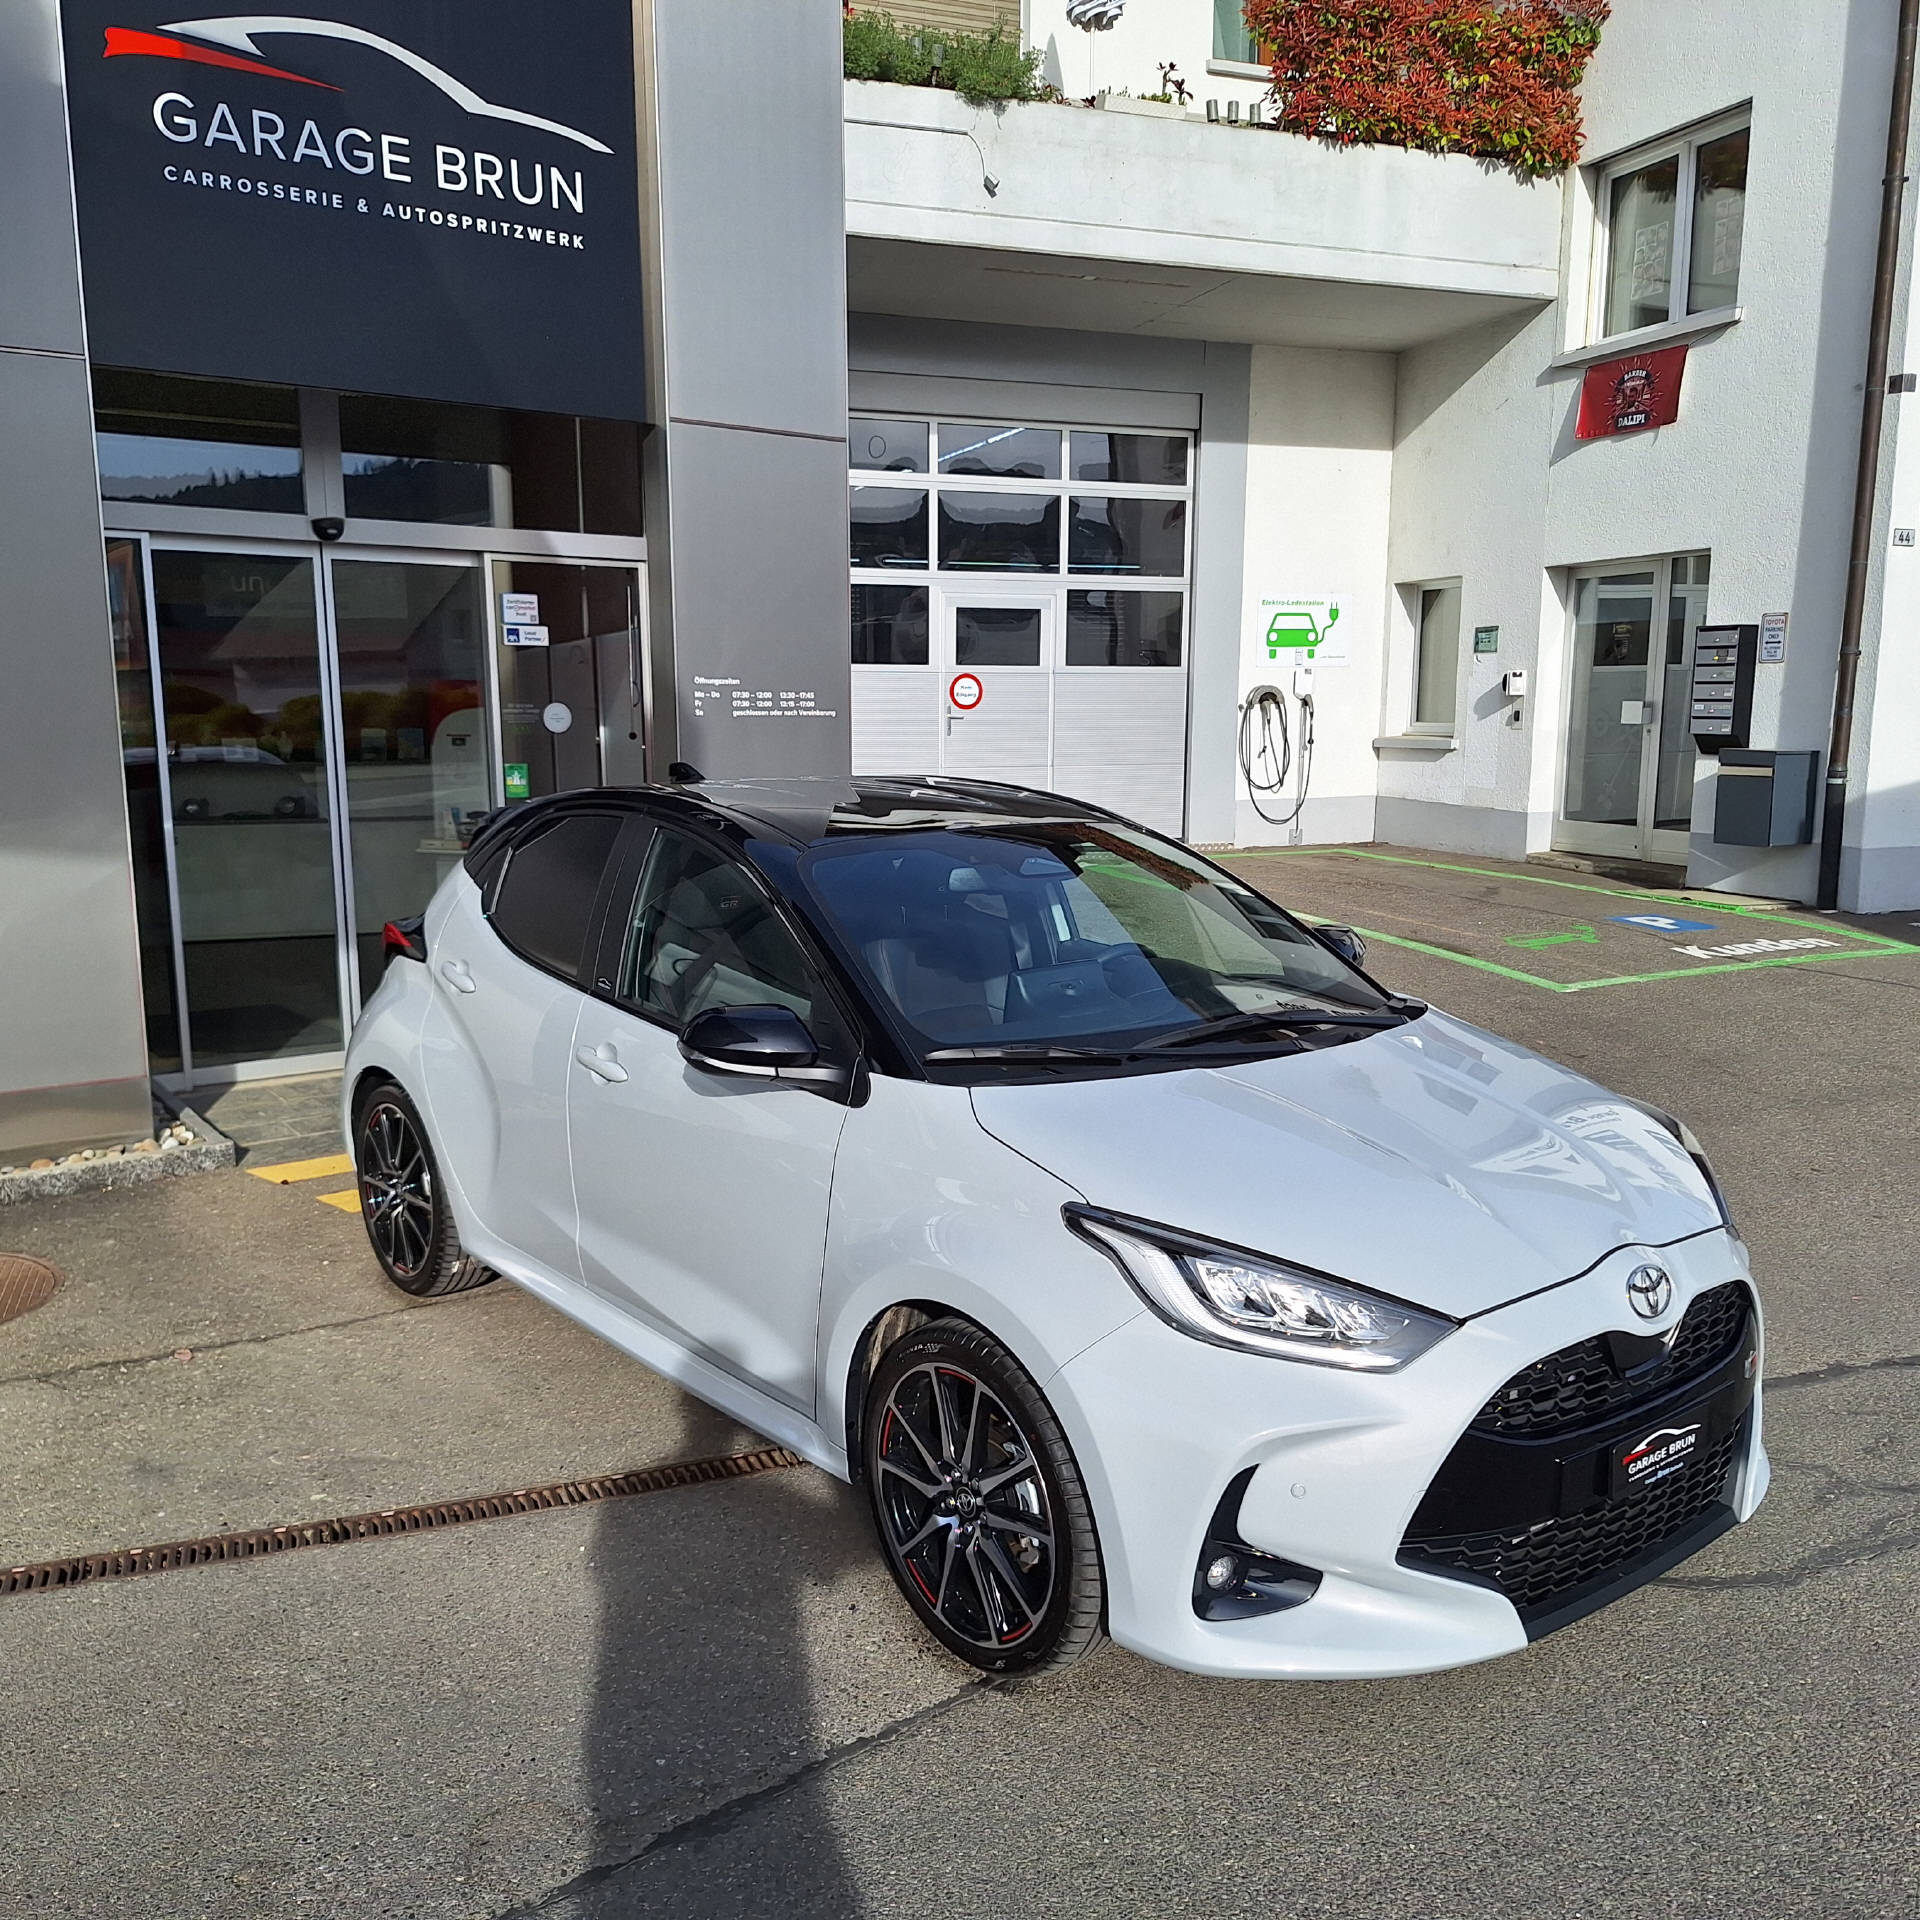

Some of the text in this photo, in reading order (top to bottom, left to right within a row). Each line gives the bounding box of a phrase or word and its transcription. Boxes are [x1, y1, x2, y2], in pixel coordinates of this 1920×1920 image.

[152, 91, 585, 214] GARAGE BRUN
[163, 165, 585, 250] CARROSSERIE & AUTOSPRITZWERK
[1618, 414, 1645, 427] DALIPI
[1898, 530, 1911, 544] 44
[1671, 937, 1842, 960] Kunden
[1628, 1446, 1668, 1475] GARAGE
[1668, 1433, 1696, 1455] BRUN
